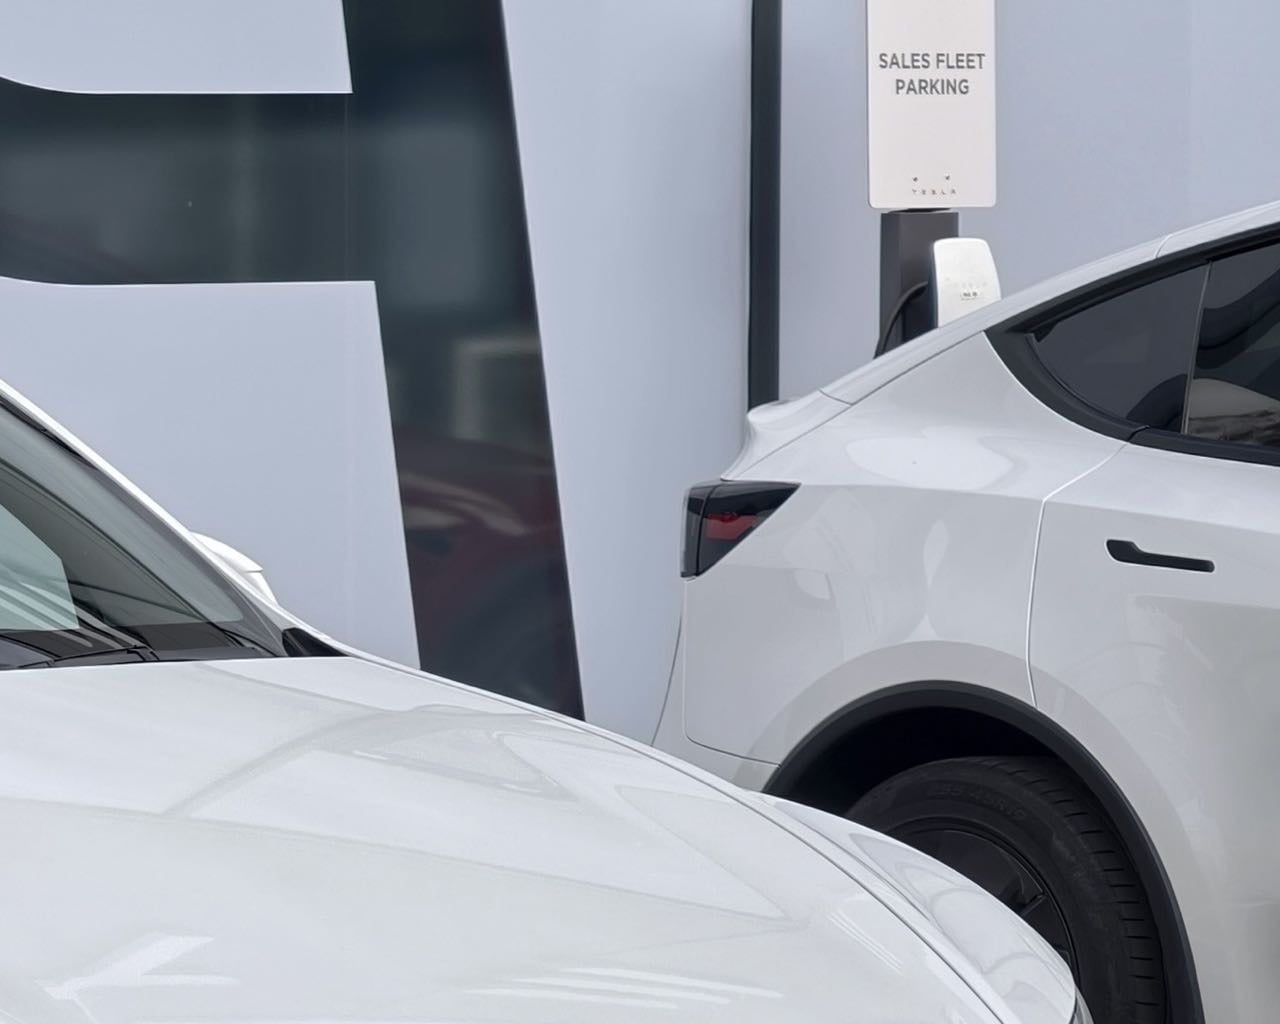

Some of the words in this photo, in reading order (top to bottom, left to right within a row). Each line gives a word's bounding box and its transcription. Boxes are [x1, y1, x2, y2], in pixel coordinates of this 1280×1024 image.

[878, 52, 931, 70] SALES
[935, 52, 986, 70] FLEET
[895, 78, 970, 95] PARKING
